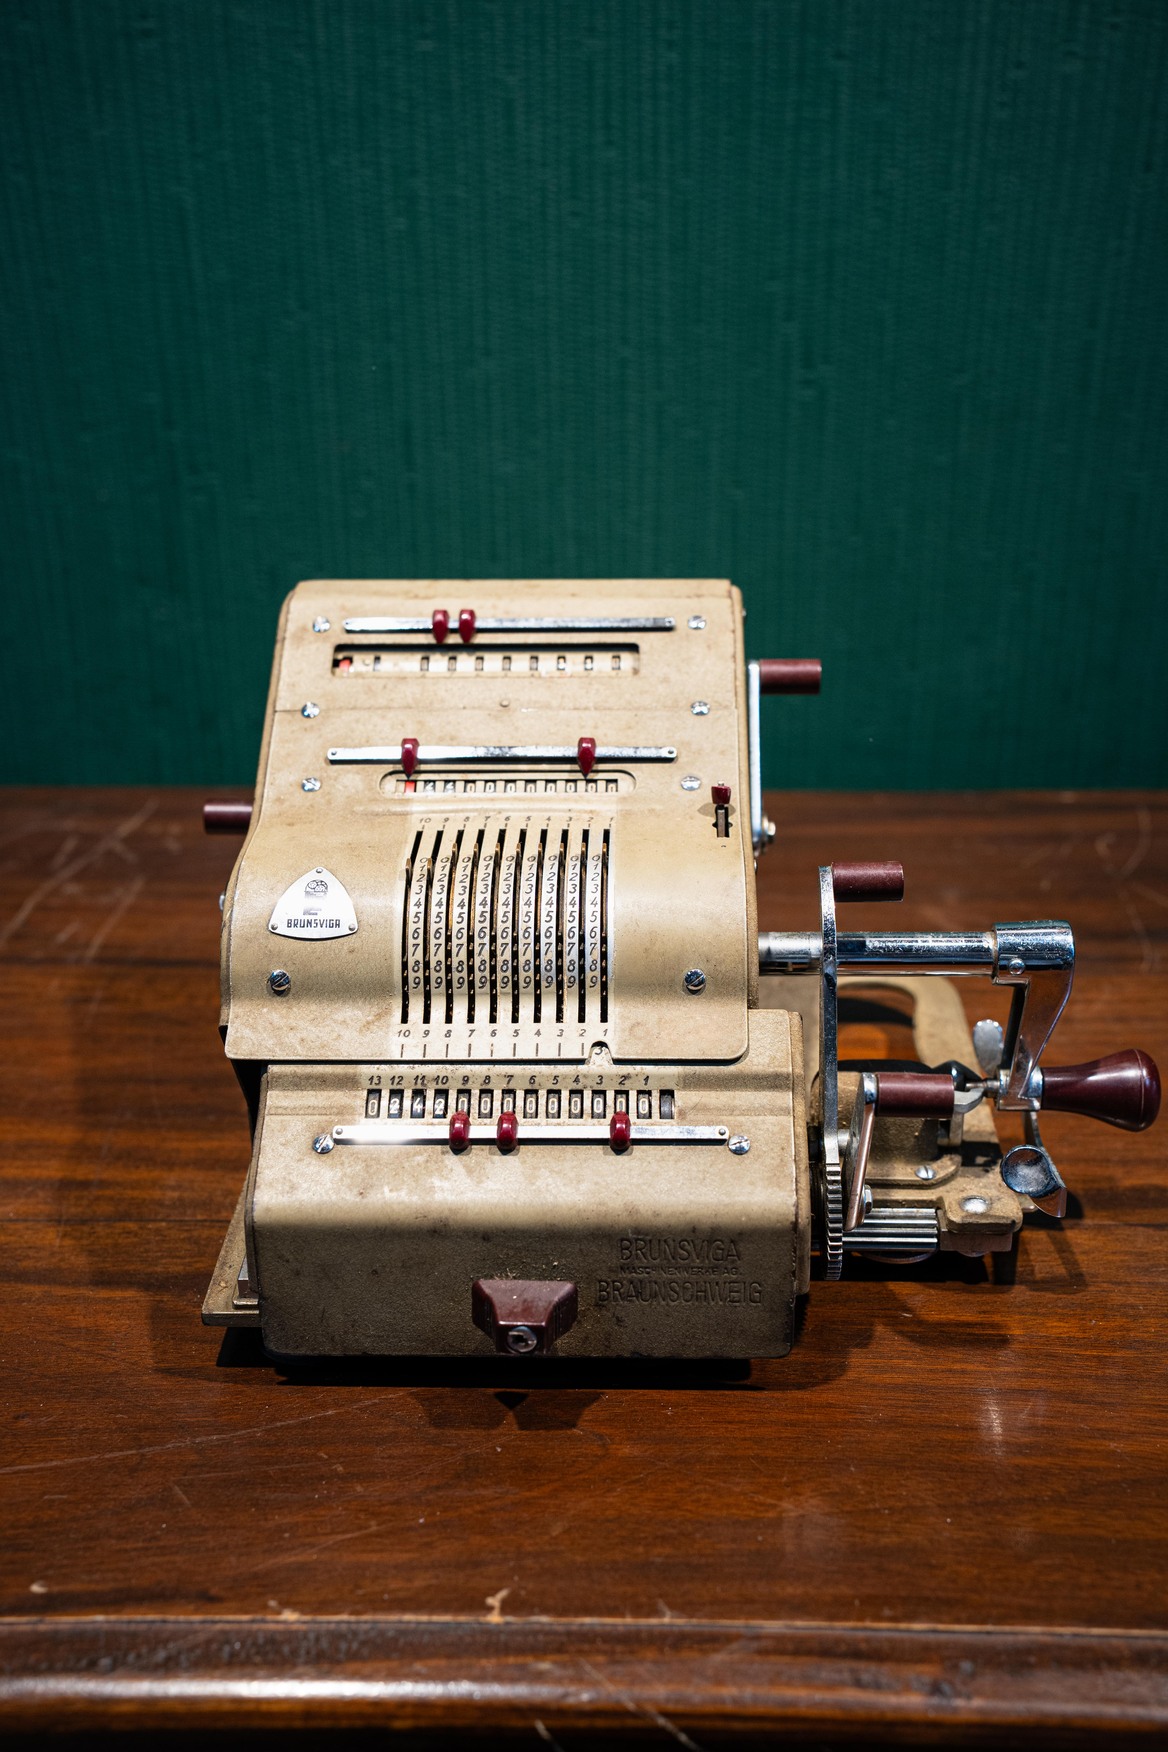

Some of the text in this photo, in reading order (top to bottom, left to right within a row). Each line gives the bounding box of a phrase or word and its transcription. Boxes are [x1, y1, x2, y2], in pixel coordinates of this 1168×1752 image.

[416, 873, 599, 883] 2 2 2 2 2 2 2 2 2
[415, 884, 599, 895] 3 3 3 3 3 3 3 3 3
[414, 897, 598, 909] 4 4 4 4 4 4 4 4 4
[286, 918, 341, 928] BRUNSVIGA
[413, 911, 598, 924] 5 5 5 5 5 5 5 5 5
[412, 926, 598, 940] 6 6 6 6 6 6 6 6 6
[412, 943, 597, 957] 7 7 7 7 7 7 7 7 7
[412, 960, 597, 973] 8 8 8 8 8 8 8 8 8
[412, 976, 598, 989] 9 9 9 9 9 9 9 9 9
[397, 1029, 608, 1038] 10 9 8 7 6 5 4 3 2 1
[368, 1075, 649, 1085] 13 12 11 10 9 8 7 6 5 4 3 2 1
[368, 1097, 648, 1115] 0 2 4 2 0 0 0 0 0 0 0 0 0
[619, 1238, 741, 1262] BRUNSVIGA
[597, 1279, 763, 1304] BRAUNSCHWEIG
